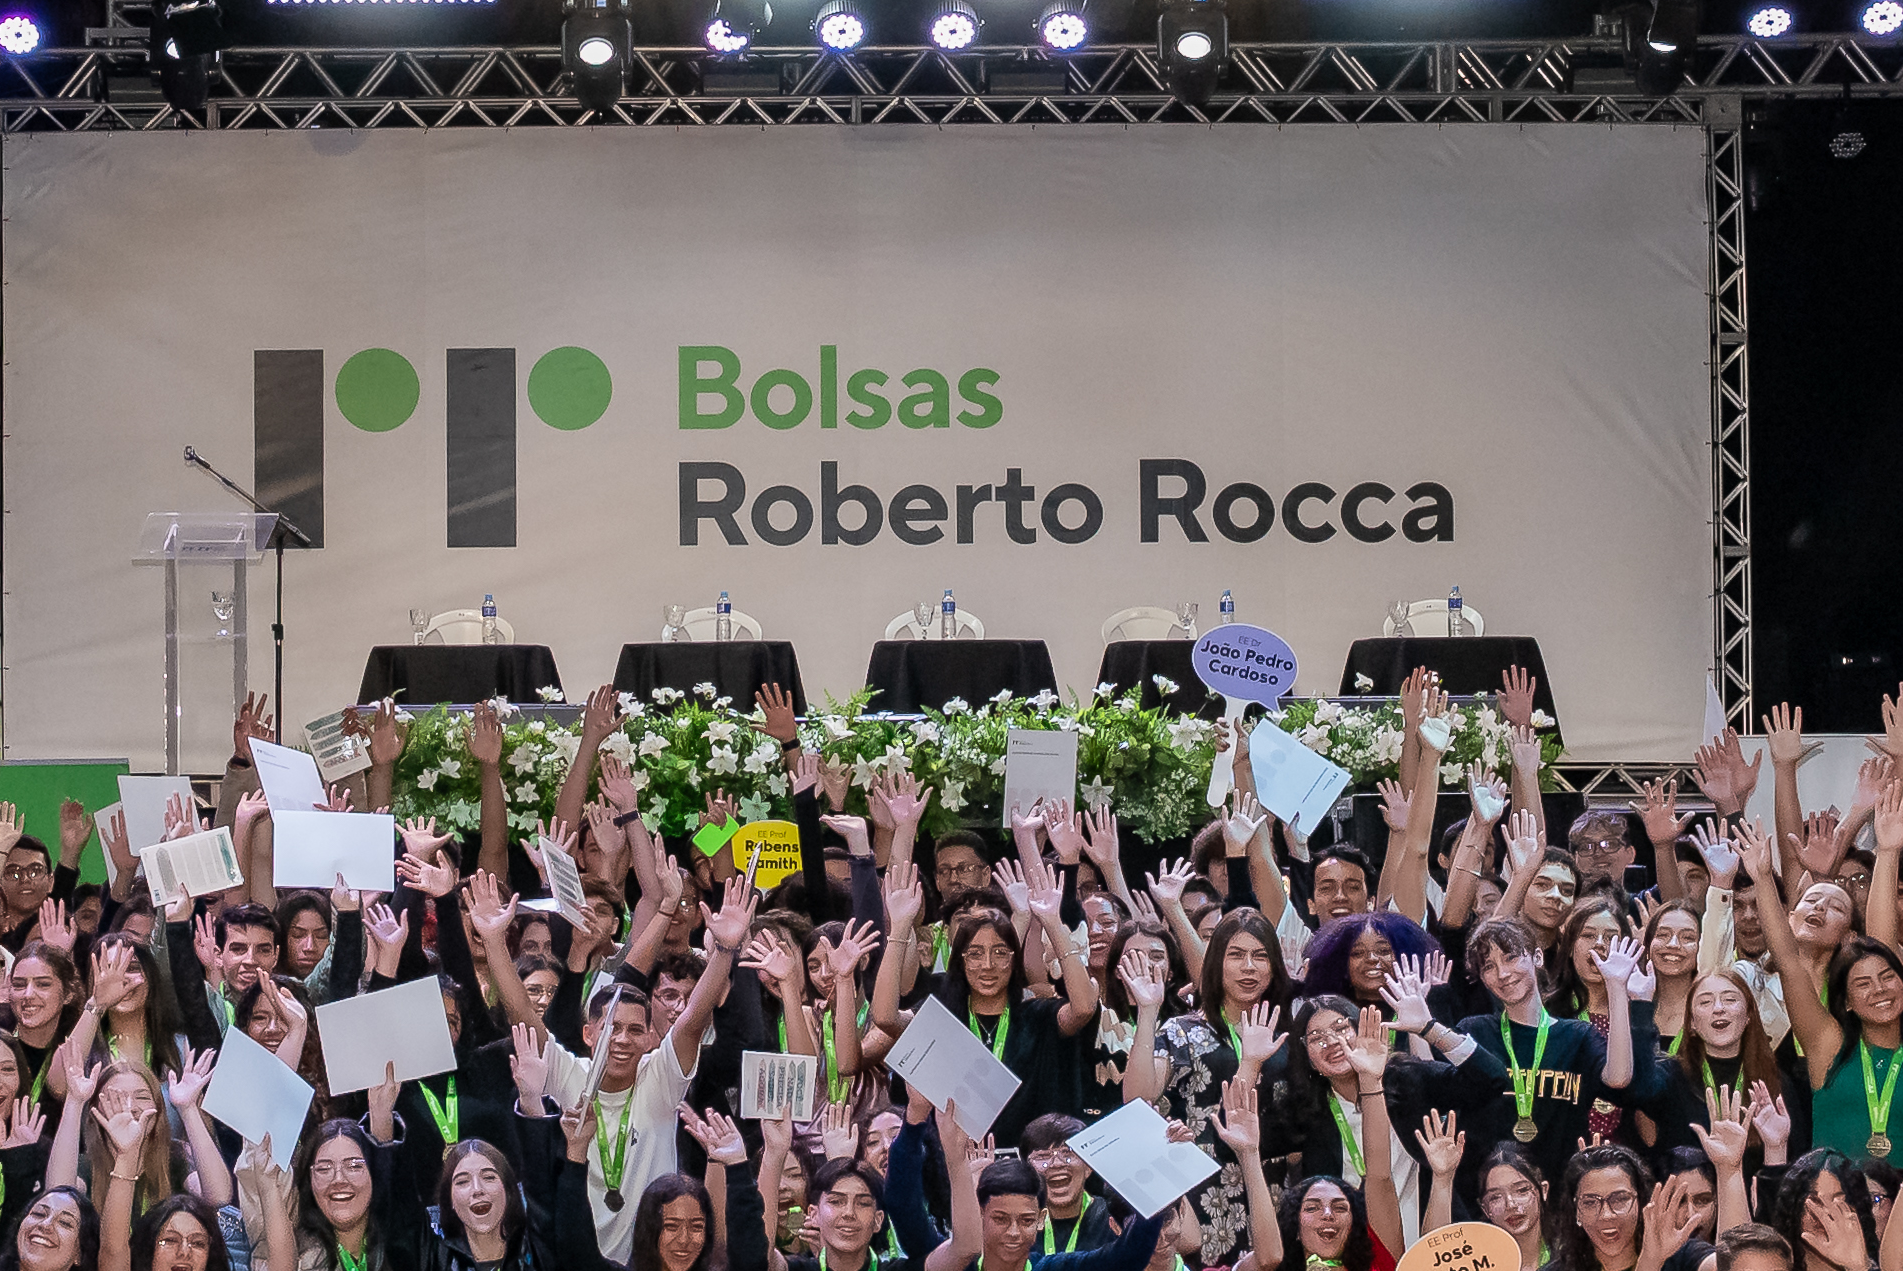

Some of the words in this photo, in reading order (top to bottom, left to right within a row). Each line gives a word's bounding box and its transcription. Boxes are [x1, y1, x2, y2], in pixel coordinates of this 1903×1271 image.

[679, 345, 1004, 430] Bolsas
[679, 461, 1104, 548] Roberto
[1139, 459, 1455, 545] Rocca
[1238, 635, 1250, 646] EE
[1200, 640, 1241, 659] João
[1244, 649, 1294, 671] Pedro
[1208, 658, 1279, 685] Cardoso
[757, 830, 767, 838] EE
[1427, 1236, 1442, 1248] EE
[1442, 1227, 1464, 1243] Prof
[1433, 1240, 1473, 1267] José
